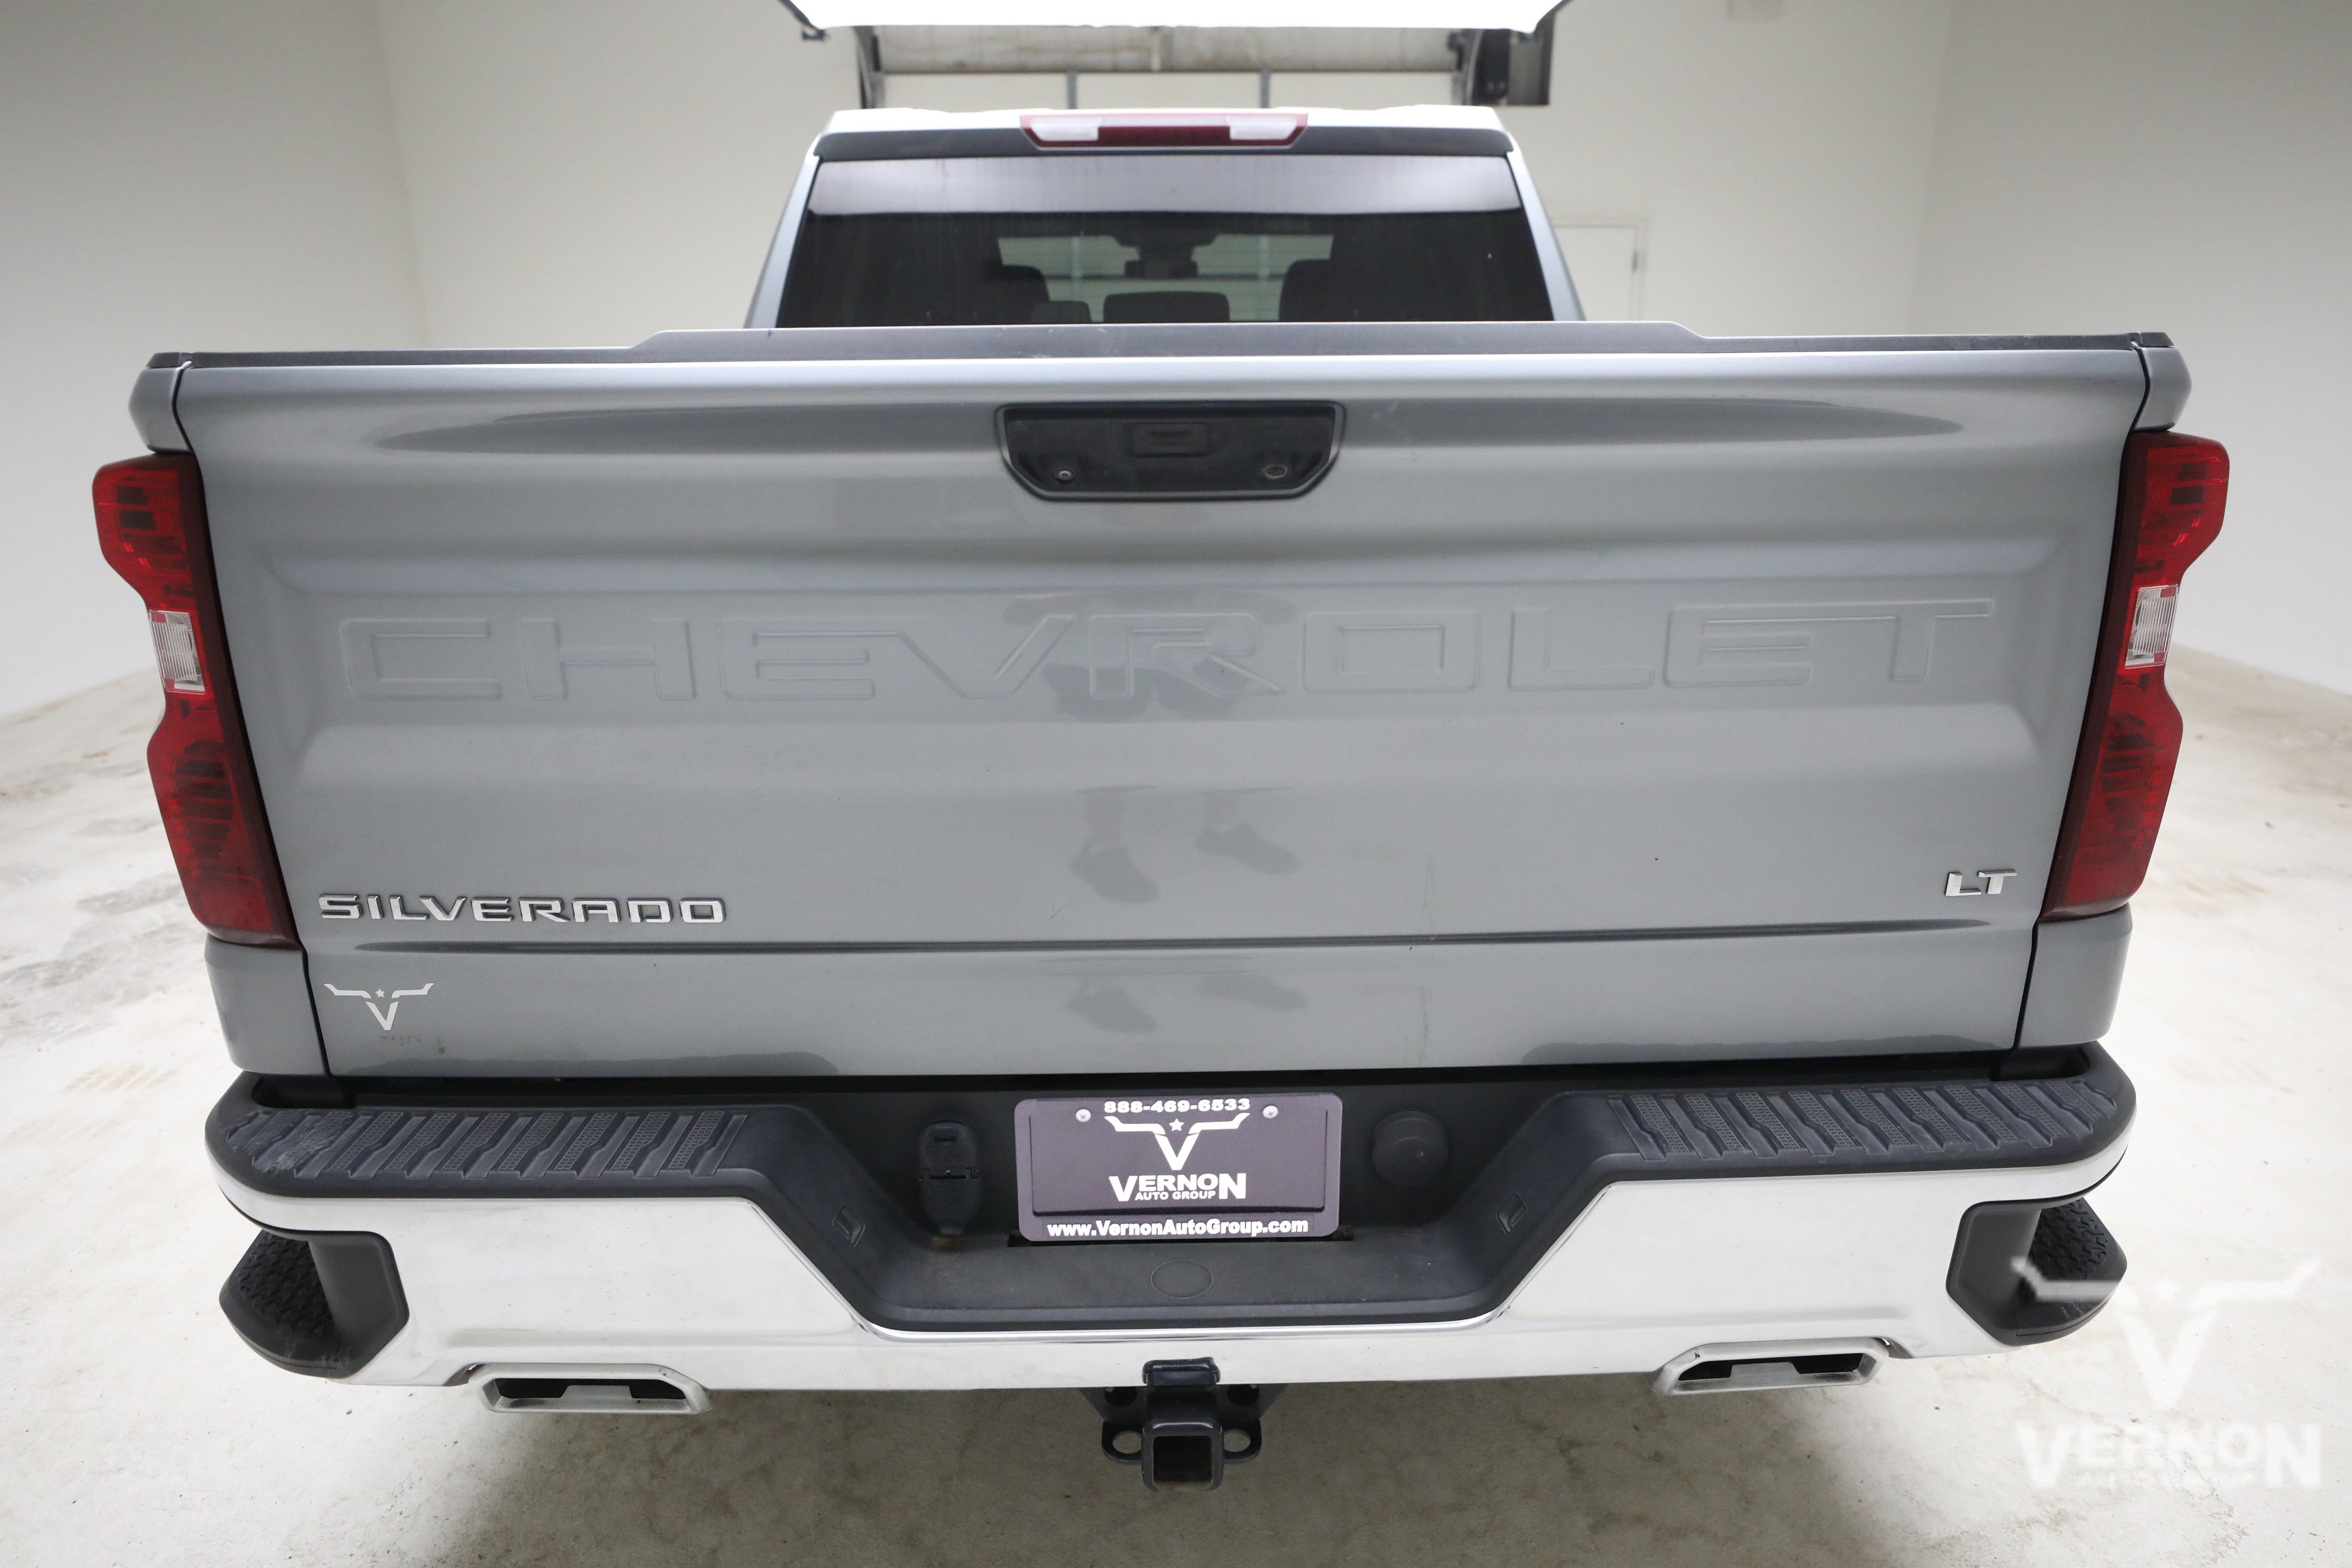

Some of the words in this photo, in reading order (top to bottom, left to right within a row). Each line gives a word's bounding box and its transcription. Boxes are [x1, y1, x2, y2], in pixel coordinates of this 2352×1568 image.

[341, 599, 1995, 700] CHEVROLET
[1945, 869, 2017, 896] LT
[319, 894, 726, 923] SILVERADO
[1104, 1098, 1251, 1113] 888-469-6533
[1109, 1173, 1246, 1202] VERNON
[1135, 1191, 1169, 1200] AUTO
[1172, 1190, 1216, 1200] GROUP
[1047, 1218, 1309, 1237] www.VernonAutoGroup.com
